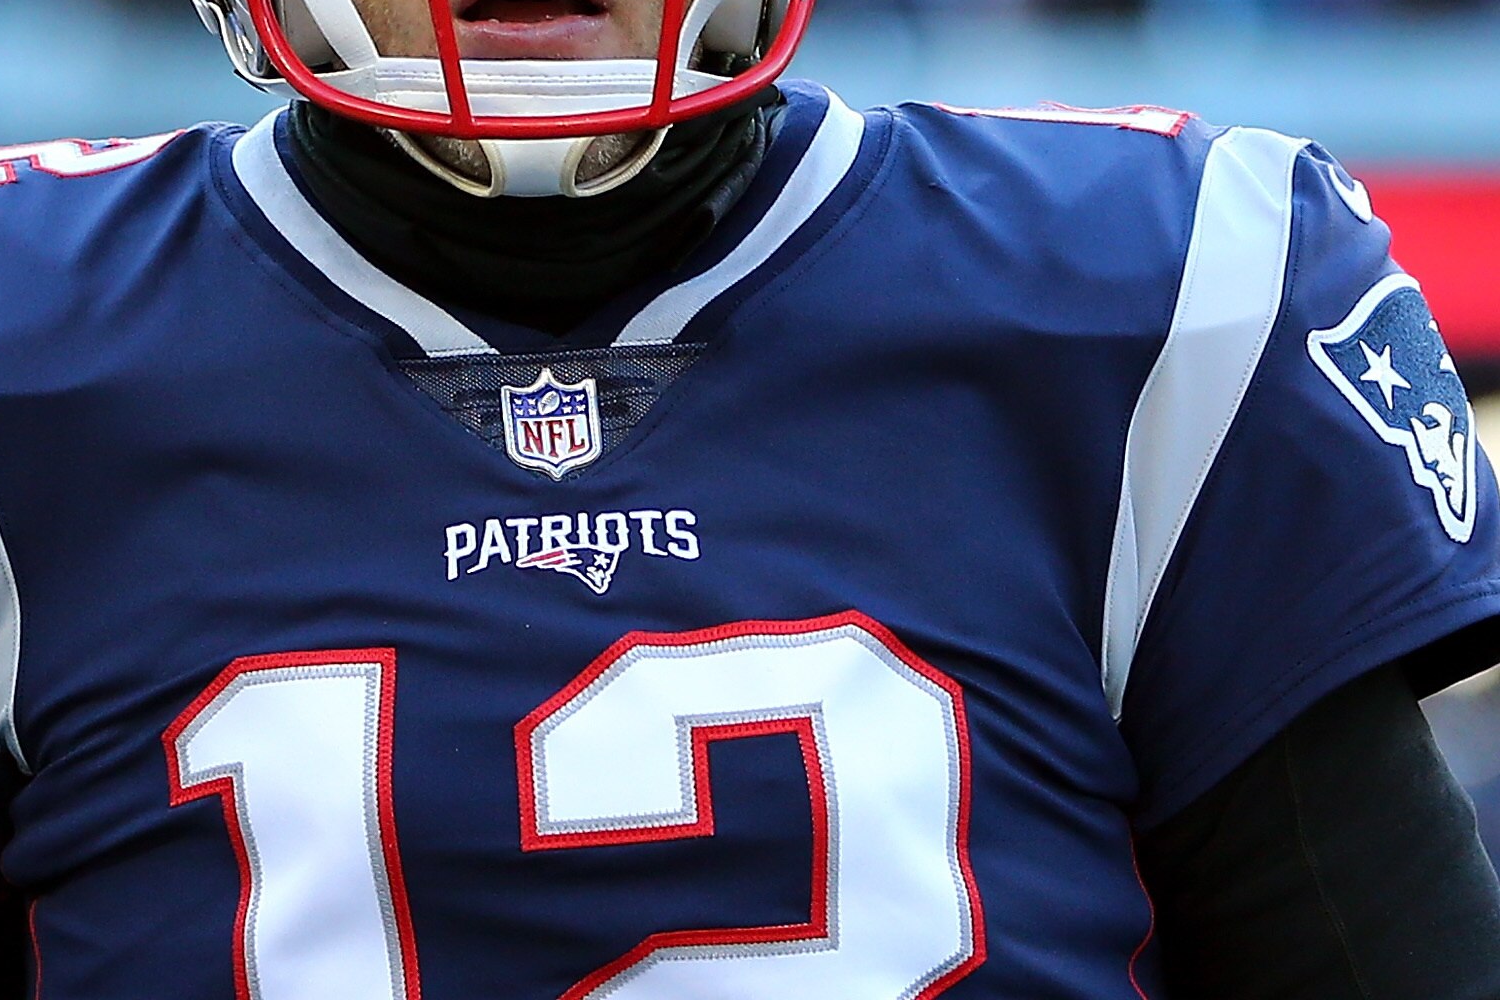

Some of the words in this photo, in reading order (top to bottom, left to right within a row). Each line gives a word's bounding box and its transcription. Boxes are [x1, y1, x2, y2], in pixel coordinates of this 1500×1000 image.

[521, 418, 586, 458] NFL
[443, 509, 701, 582] PATRIOTS
[161, 609, 988, 1000] 12
